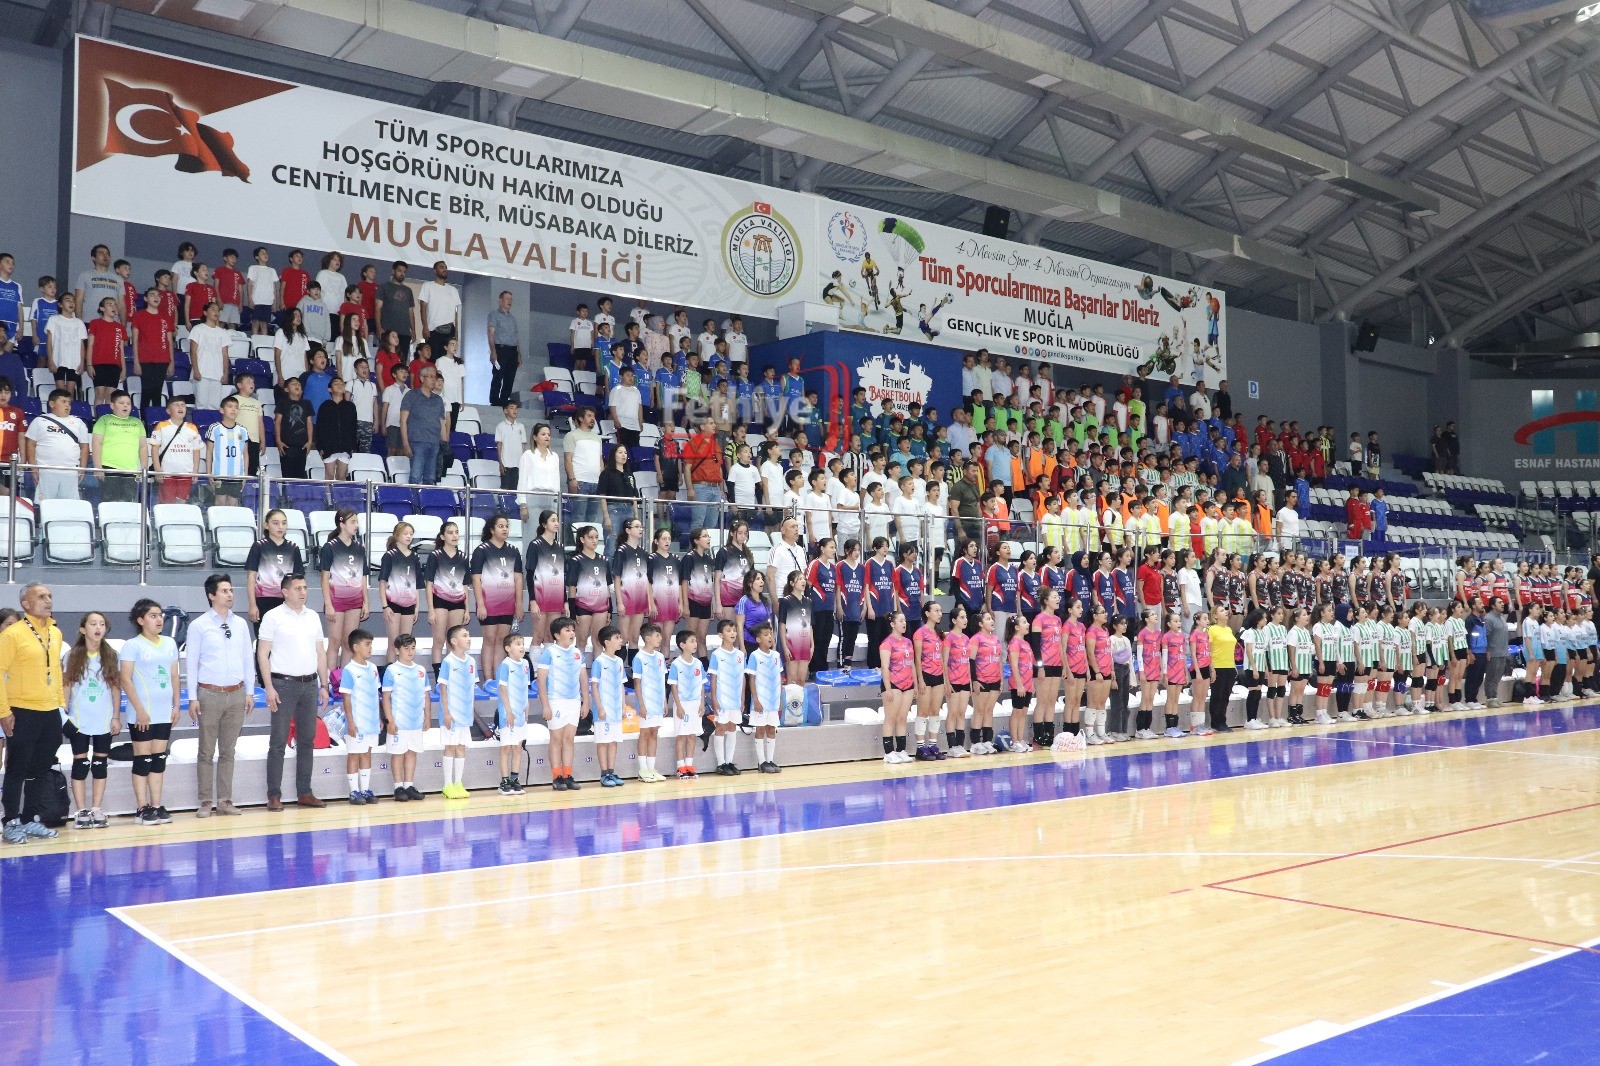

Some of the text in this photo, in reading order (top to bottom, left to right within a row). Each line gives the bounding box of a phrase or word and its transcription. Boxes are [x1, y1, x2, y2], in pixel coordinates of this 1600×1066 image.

[374, 118, 624, 188] TÜM SPORCULARIMIZA
[322, 140, 663, 222] HOŞGÖRÜNÜN HAKİM OLDUĞU
[271, 164, 698, 257] CENTİLMENCE BİR, MÜSABAKA DİLERİZ.
[732, 219, 755, 252] MUĞLA
[346, 212, 642, 285] MUĞLA VALİLİĞİ
[955, 238, 1131, 293] 4 Mevsim Spor, 4 Mevsim Organizasyon
[918, 256, 1160, 327] Tüm Sporcularımıza Başarılar Dileriz
[1024, 308, 1074, 332] MUĞLA
[947, 318, 1140, 360] GENÇLİK VE SPOR İL MÜDÜRLÜĞÜ
[881, 374, 911, 390] FETHİYE
[1250, 382, 1258, 395] D
[868, 386, 922, 405] BASKETBOLLA
[226, 446, 236, 458] 10
[1514, 458, 1552, 469] ESNAF
[276, 554, 284, 564] 5
[348, 556, 355, 565] 2
[500, 557, 506, 566] 11
[552, 554, 556, 563] 7
[636, 558, 641, 566] 9
[406, 566, 410, 575] 1
[450, 567, 456, 576] 4
[594, 566, 600, 575] 8
[666, 566, 672, 574] 12
[801, 608, 806, 617] 3
[555, 710, 560, 719] 4
[604, 723, 610, 732] 3
[358, 733, 364, 742] 9
[394, 734, 398, 743] 5
